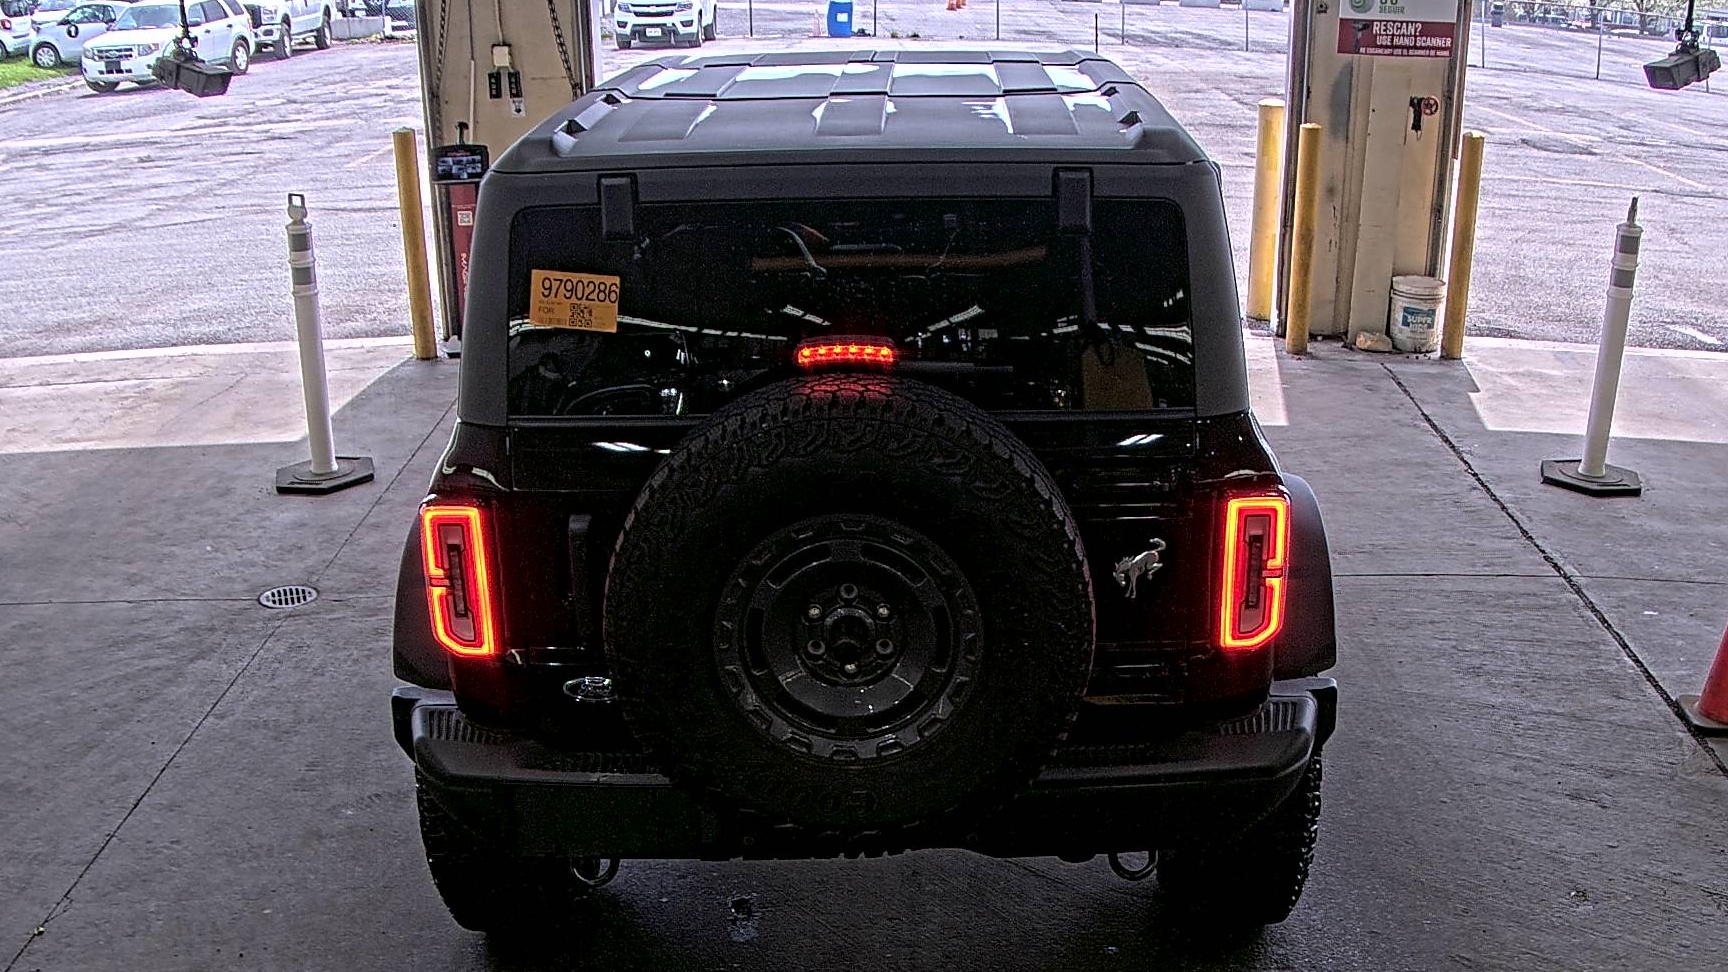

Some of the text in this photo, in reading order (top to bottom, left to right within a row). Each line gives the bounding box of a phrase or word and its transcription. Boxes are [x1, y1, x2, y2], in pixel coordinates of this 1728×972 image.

[1373, 21, 1422, 35] RESCAN?
[1376, 36, 1452, 48] USE HAND SCANNER
[541, 276, 618, 303] 9790286
